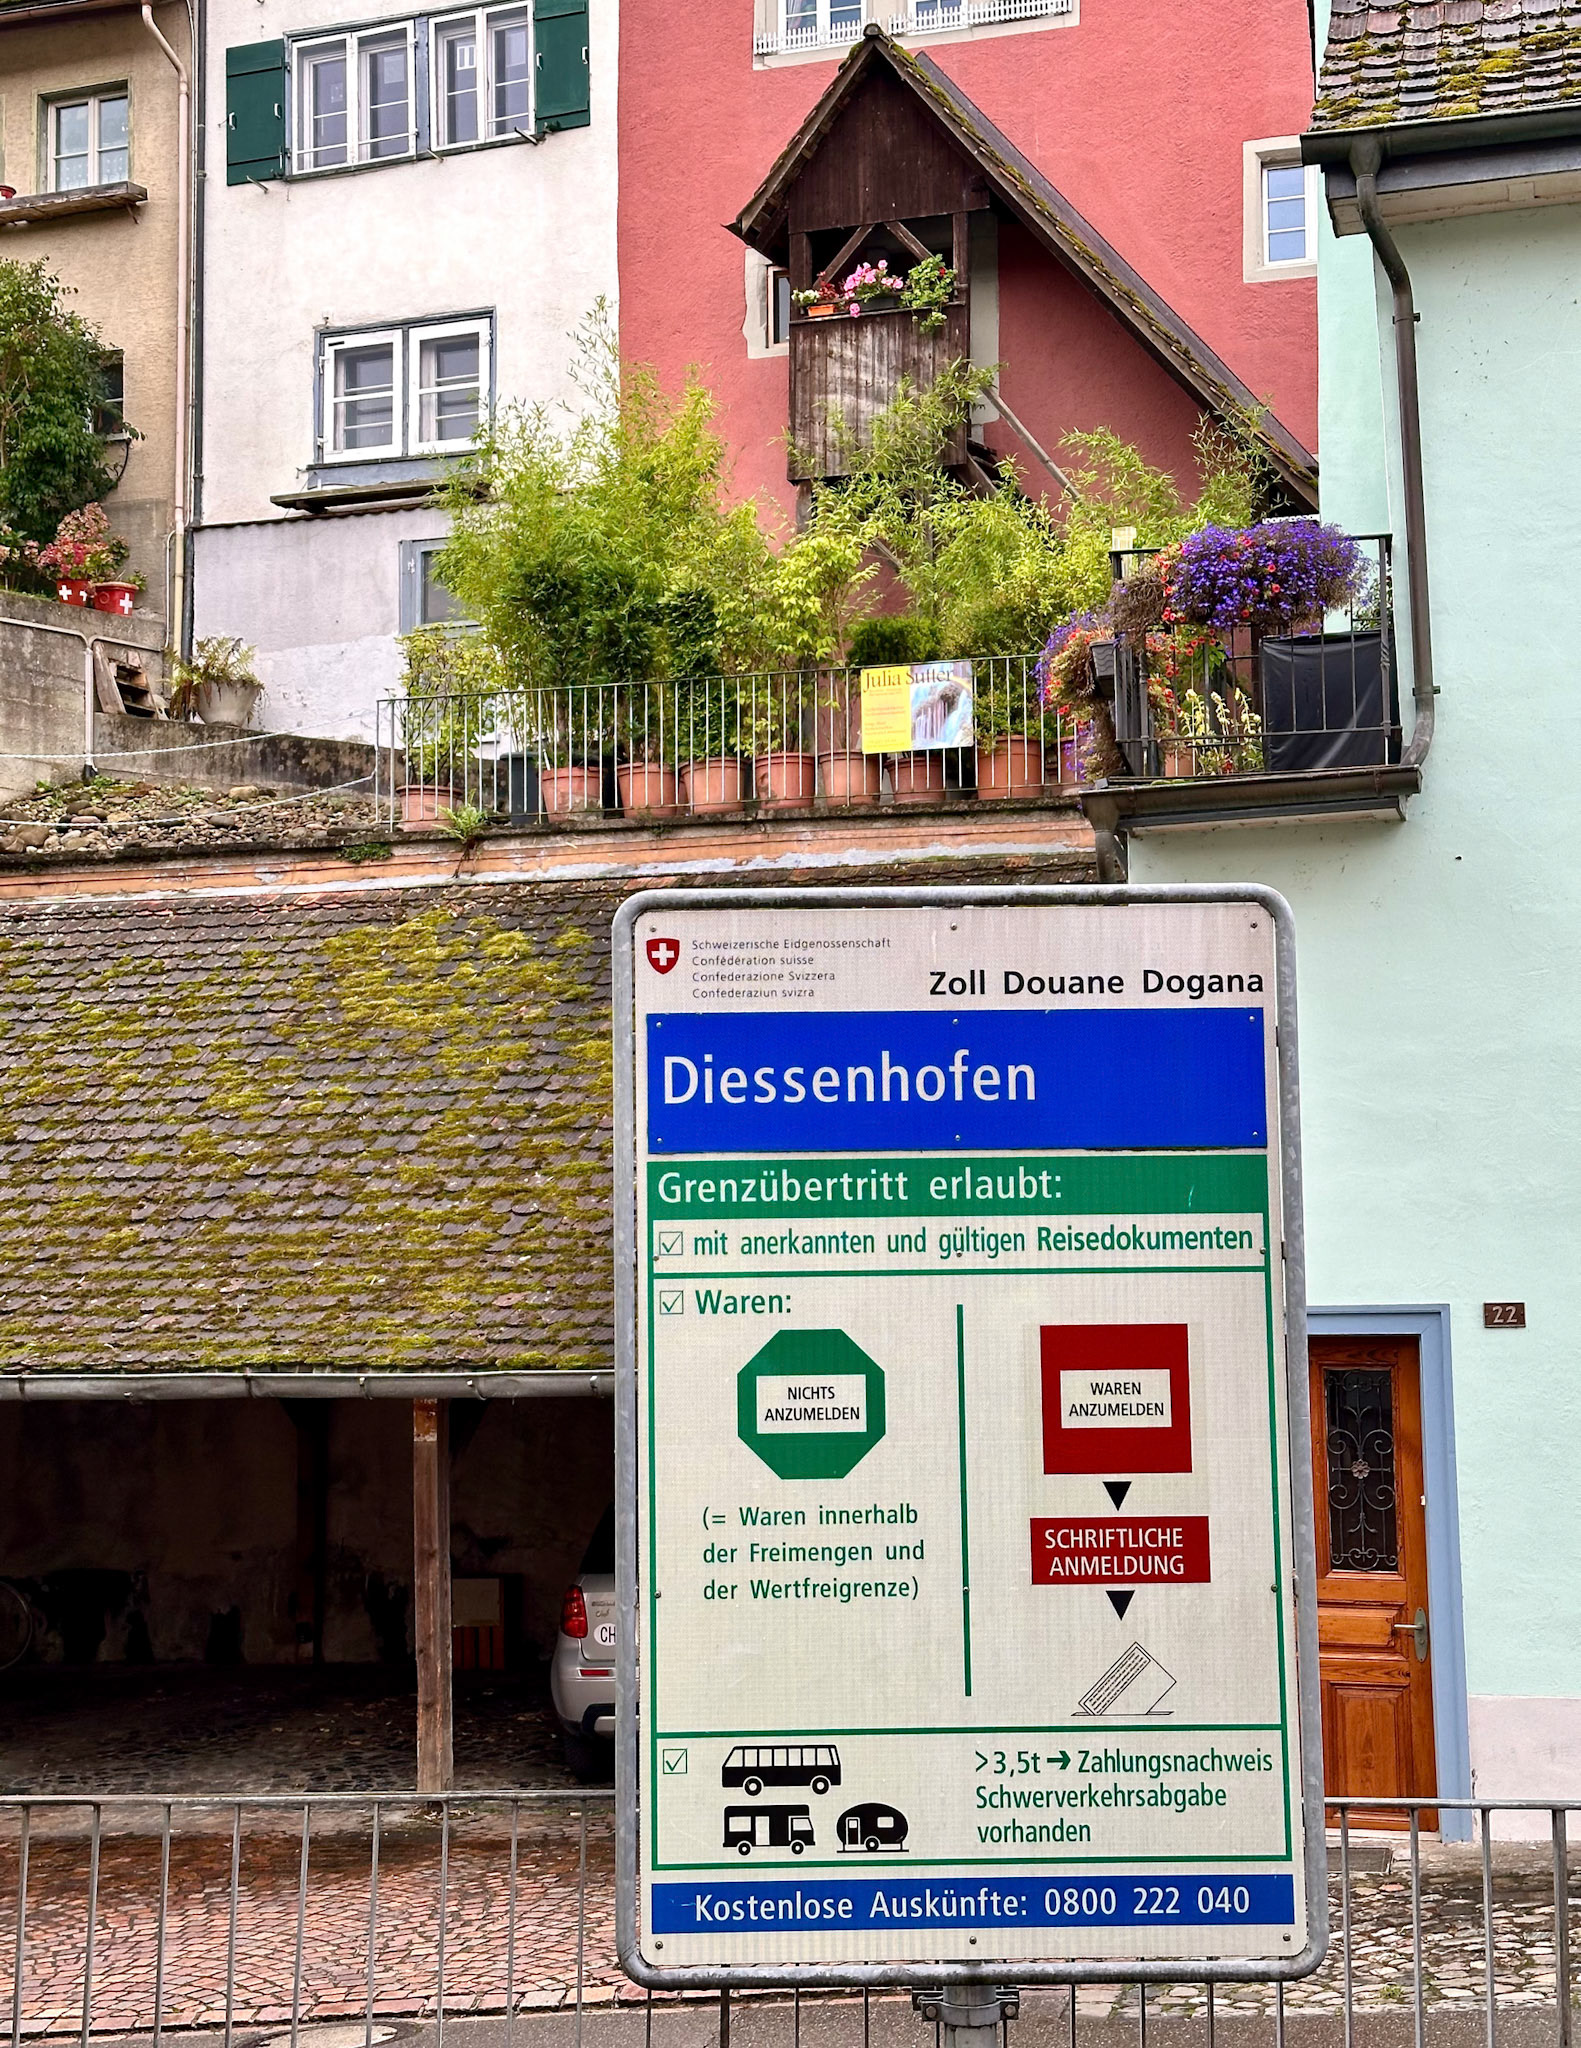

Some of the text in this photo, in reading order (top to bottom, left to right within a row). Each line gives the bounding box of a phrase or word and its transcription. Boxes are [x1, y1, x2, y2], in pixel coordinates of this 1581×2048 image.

[863, 671, 902, 693] Julia
[905, 668, 954, 686] Sutter
[692, 937, 891, 952] Schweizerische Eidgenossenschaft
[692, 955, 814, 967] Confédération suisse
[692, 970, 836, 982] Confederazione Svizzera
[929, 969, 1264, 998] Zoll Douane Dogana
[692, 987, 815, 999] Confederaziun svizra
[664, 1048, 1036, 1104] Diessenhofen
[658, 1165, 1062, 1204] Grenzübertritt erlaubt:
[693, 1223, 1253, 1260] mit anerkannten und gültigen Reisedokumenten
[695, 1289, 791, 1315] Waren:
[1492, 1305, 1518, 1324] 22
[787, 1386, 836, 1400] NICHTS
[1090, 1381, 1142, 1396] WAREN
[764, 1406, 860, 1422] ANZUMELDEN
[1068, 1402, 1164, 1417] ANZUMELDEN
[738, 1506, 806, 1526] Waren
[819, 1502, 918, 1525] innerhalb
[1044, 1527, 1184, 1549] SCHRIFTLICHE
[703, 1539, 925, 1567] der Freimengen und
[1049, 1554, 1184, 1577] ANMELDUNG
[703, 1575, 919, 1604] der Wertfreigrenze)
[600, 1626, 616, 1643] CH
[1077, 1747, 1273, 1779] Zahlungsnachweis
[976, 1781, 1227, 1812] Schwerverkehrsabgabe
[977, 1817, 1091, 1844] vorhanden
[696, 1886, 1250, 1922] Kostenlose Auskünfte: 0800 222 040
